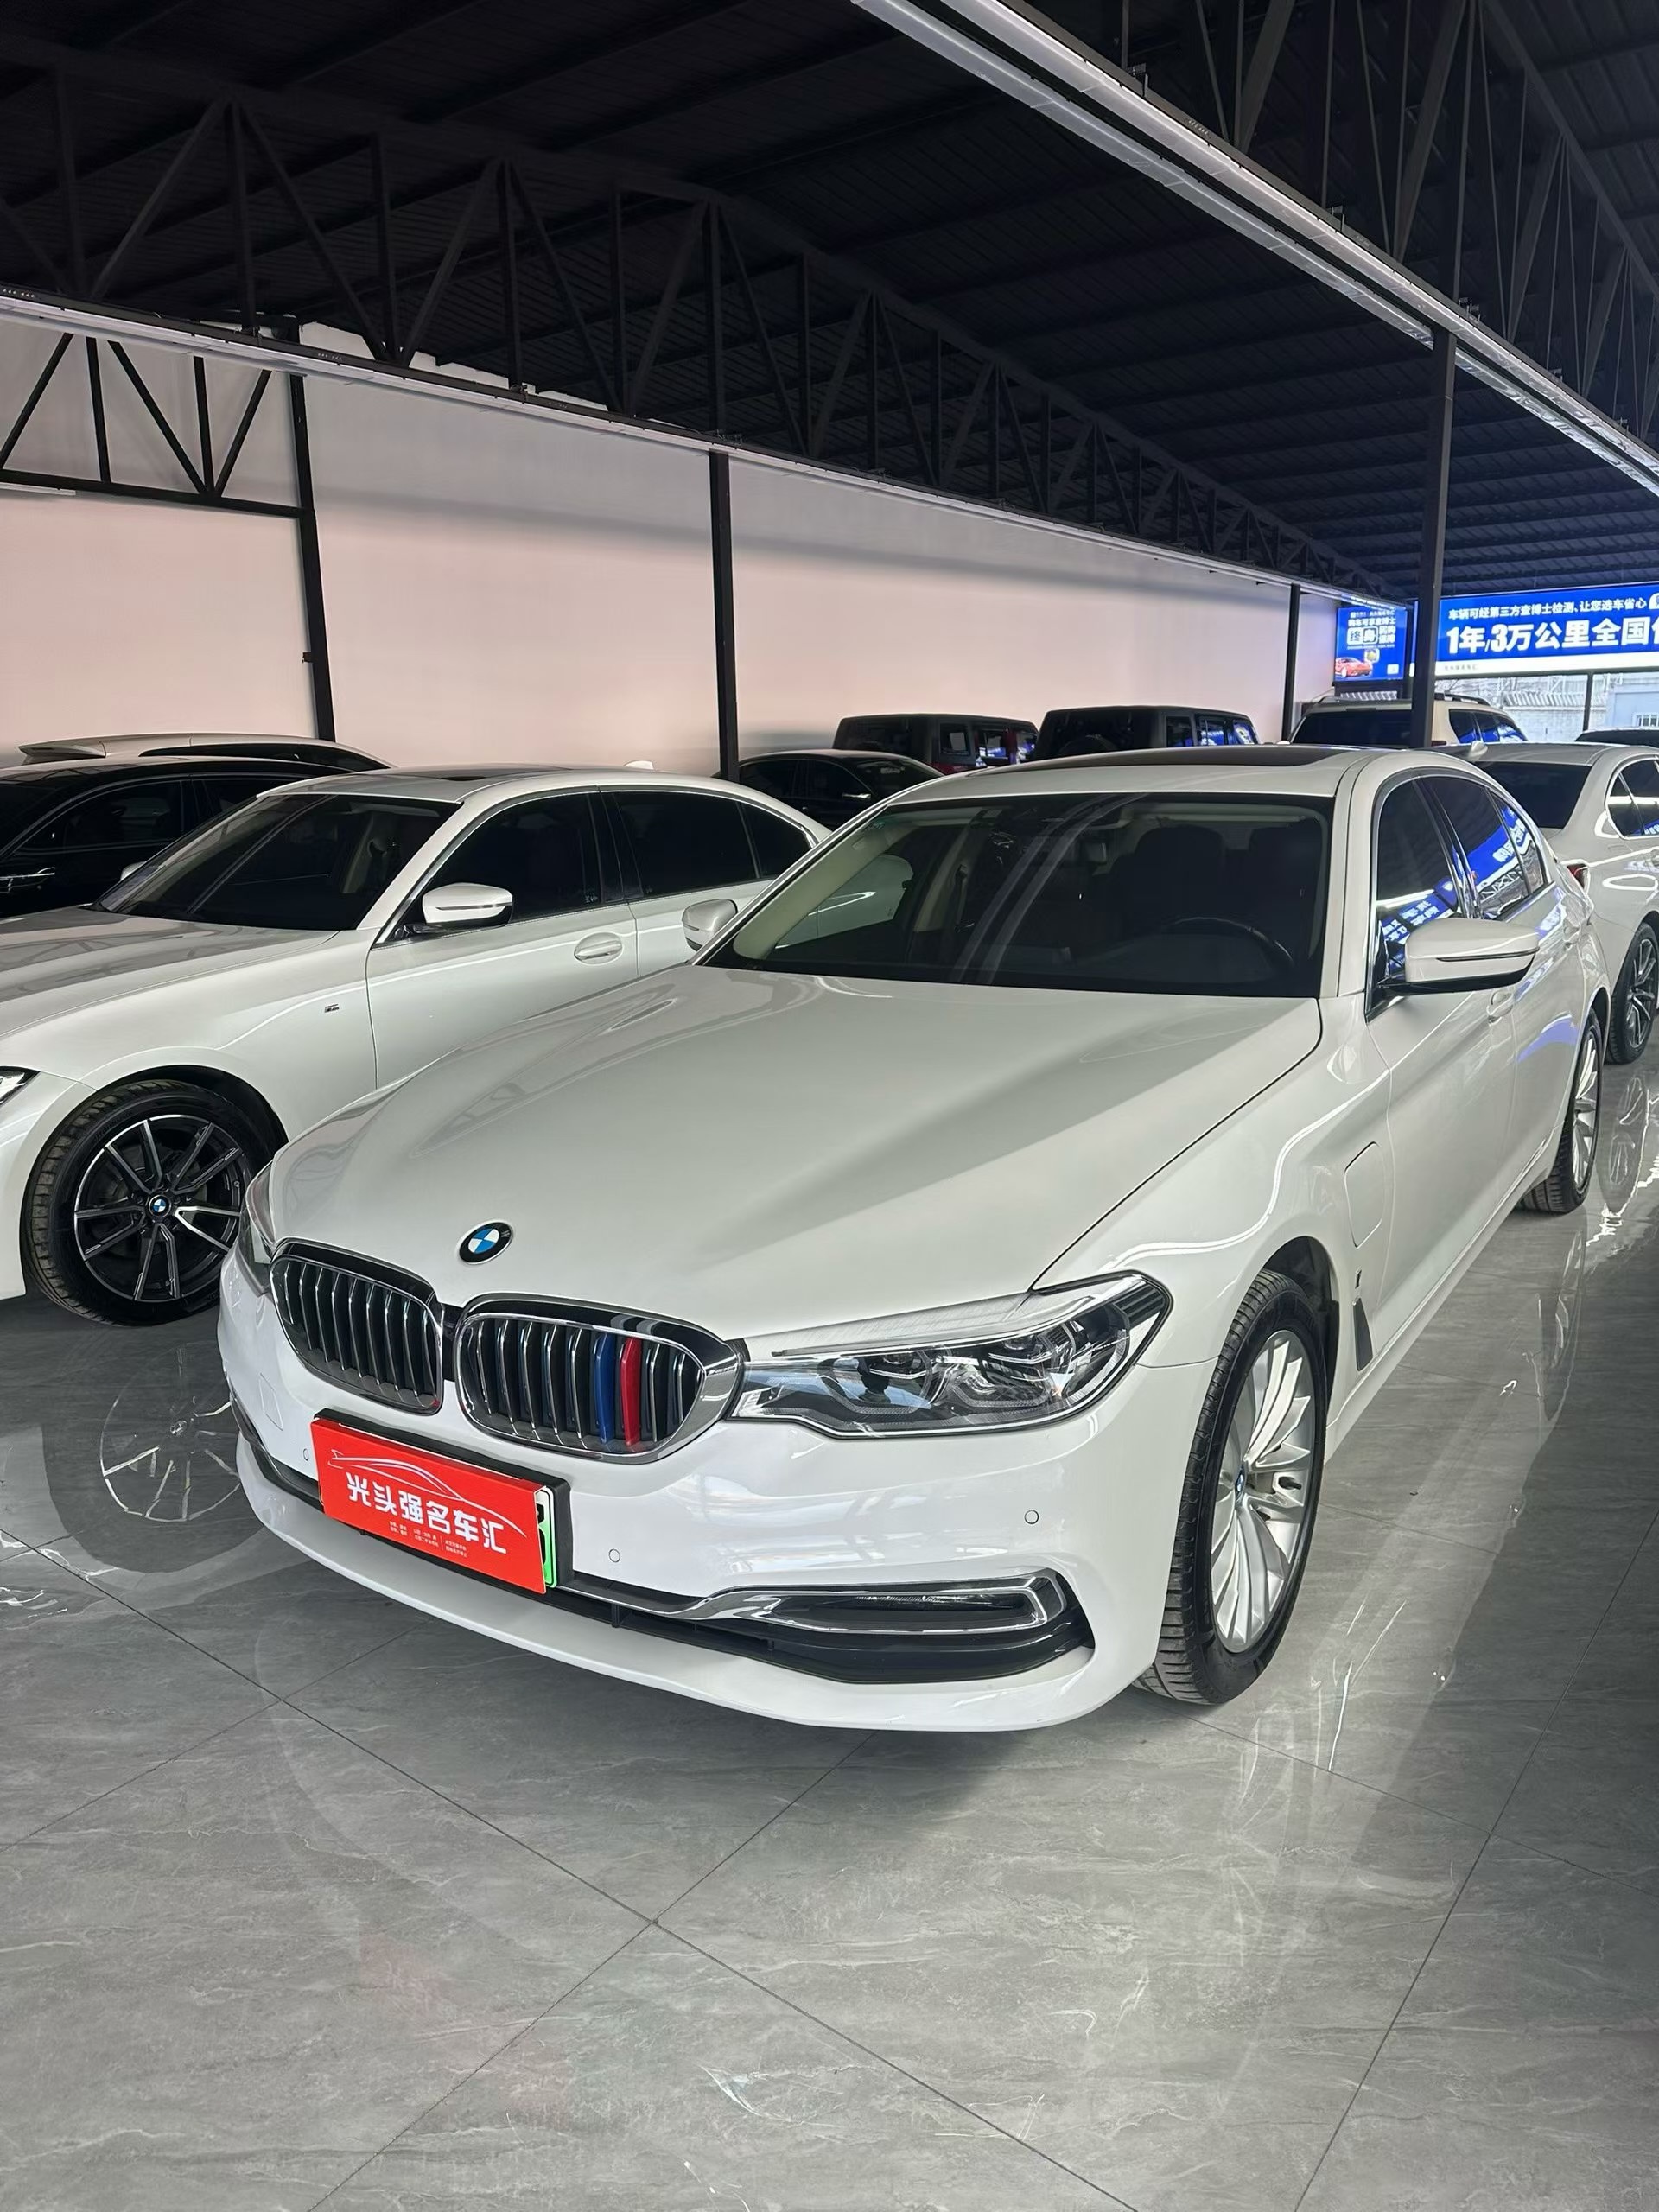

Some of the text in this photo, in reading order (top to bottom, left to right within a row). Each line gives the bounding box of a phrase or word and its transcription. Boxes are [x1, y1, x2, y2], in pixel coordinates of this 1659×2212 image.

[1446, 616, 1659, 654] 1年/3万公里全国
[345, 1471, 508, 1554] 光头强名车汇
